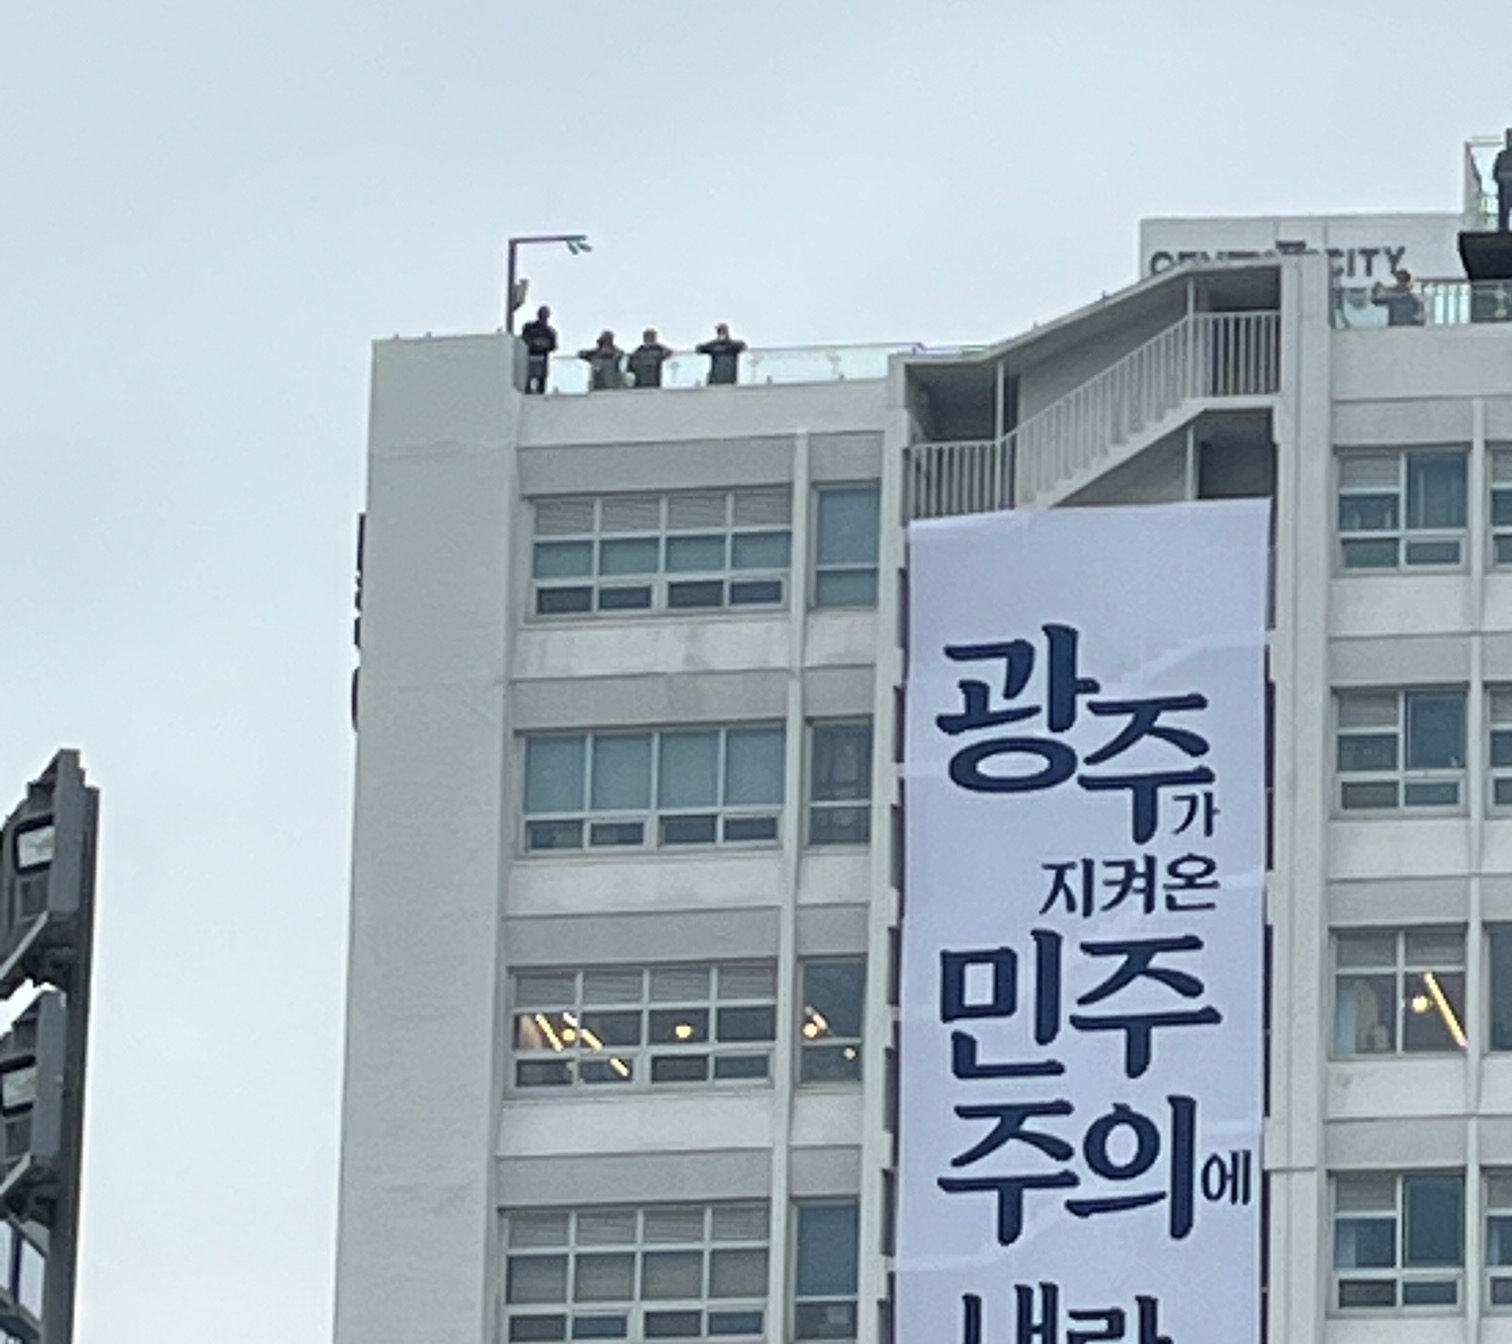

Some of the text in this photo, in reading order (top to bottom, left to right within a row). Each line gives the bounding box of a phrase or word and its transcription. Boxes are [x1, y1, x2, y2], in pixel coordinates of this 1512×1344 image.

[935, 624, 1221, 845] 광주가
[1039, 852, 1221, 918] 지켜온
[940, 929, 1223, 1080] 민주
[937, 1095, 1252, 1246] 주의에
